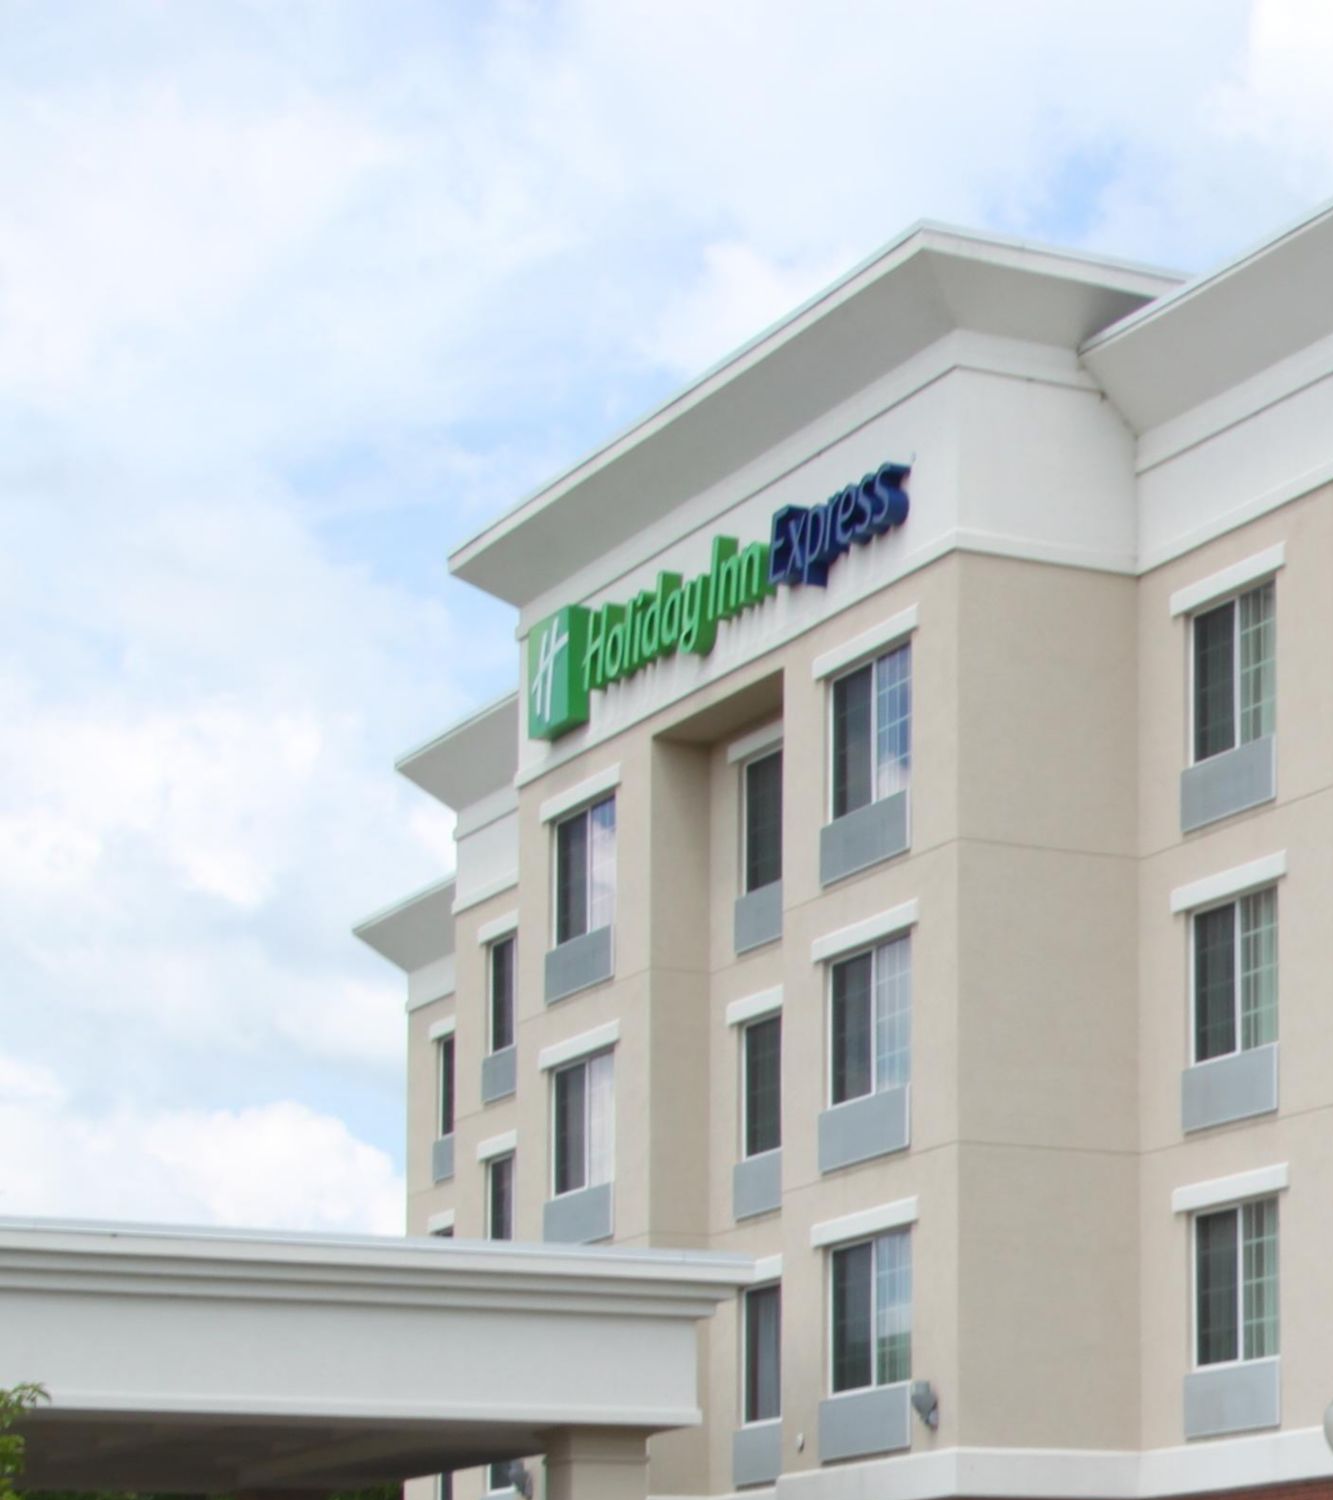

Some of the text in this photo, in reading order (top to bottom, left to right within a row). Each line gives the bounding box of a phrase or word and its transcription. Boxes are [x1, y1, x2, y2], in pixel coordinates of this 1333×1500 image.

[582, 463, 911, 690] Holiday Inn Express
